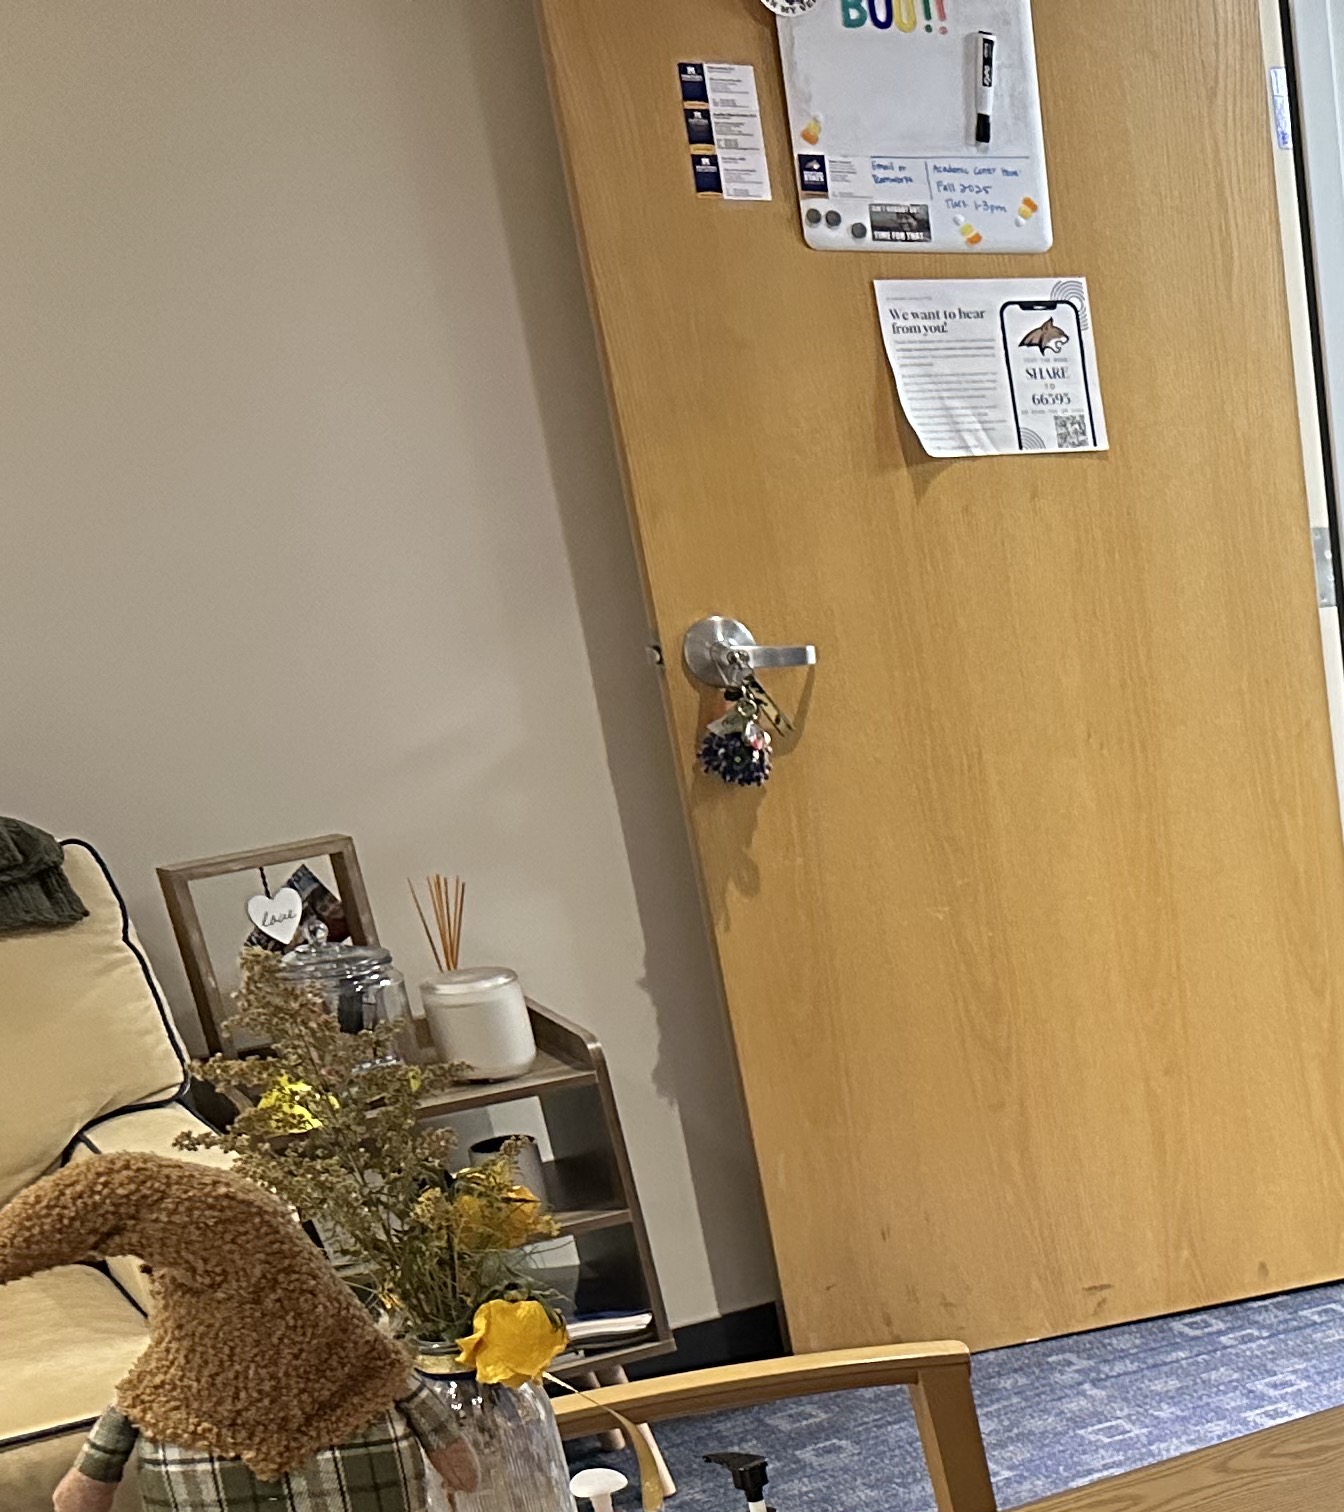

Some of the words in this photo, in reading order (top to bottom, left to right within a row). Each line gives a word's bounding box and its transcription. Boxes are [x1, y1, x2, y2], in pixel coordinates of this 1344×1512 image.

[936, 181, 955, 192] Fall
[960, 184, 992, 194] 2025
[888, 308, 910, 321] We
[911, 310, 940, 320] want
[944, 310, 956, 320] to
[958, 308, 986, 320] hear
[892, 322, 921, 334] from
[923, 321, 948, 336] you!
[1025, 367, 1069, 380] SHARE
[262, 910, 297, 927] love
